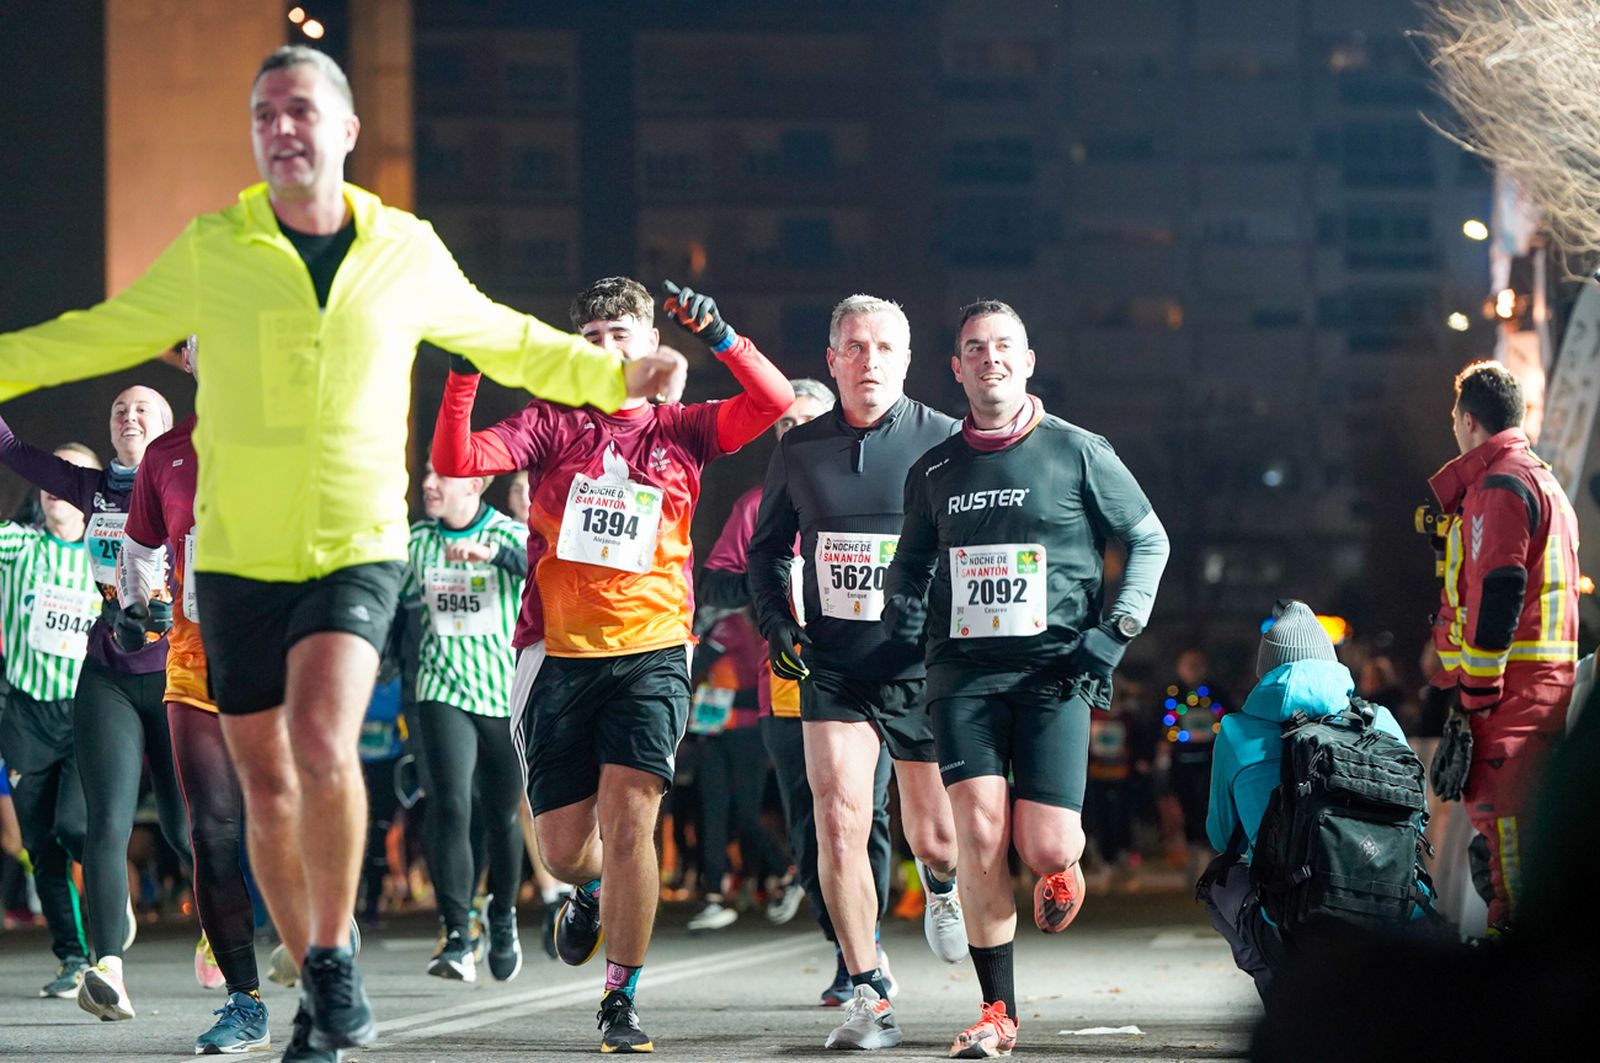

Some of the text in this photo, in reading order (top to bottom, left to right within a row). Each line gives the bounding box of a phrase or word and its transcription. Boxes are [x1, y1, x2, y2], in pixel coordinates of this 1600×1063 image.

[575, 495, 594, 506] SAN
[617, 490, 626, 499] D
[948, 488, 1026, 515] RUSTER
[581, 507, 639, 540] 1394
[93, 529, 108, 538] SAN
[98, 539, 121, 560] 26
[832, 542, 872, 552] NOCHE DE
[823, 552, 840, 562] SAN
[969, 554, 1008, 565] NOCHE DE
[830, 564, 887, 591] 5620
[961, 567, 977, 577] SAN
[967, 577, 1028, 606] 2092
[437, 593, 481, 613] 5945
[45, 610, 93, 637] 5944
